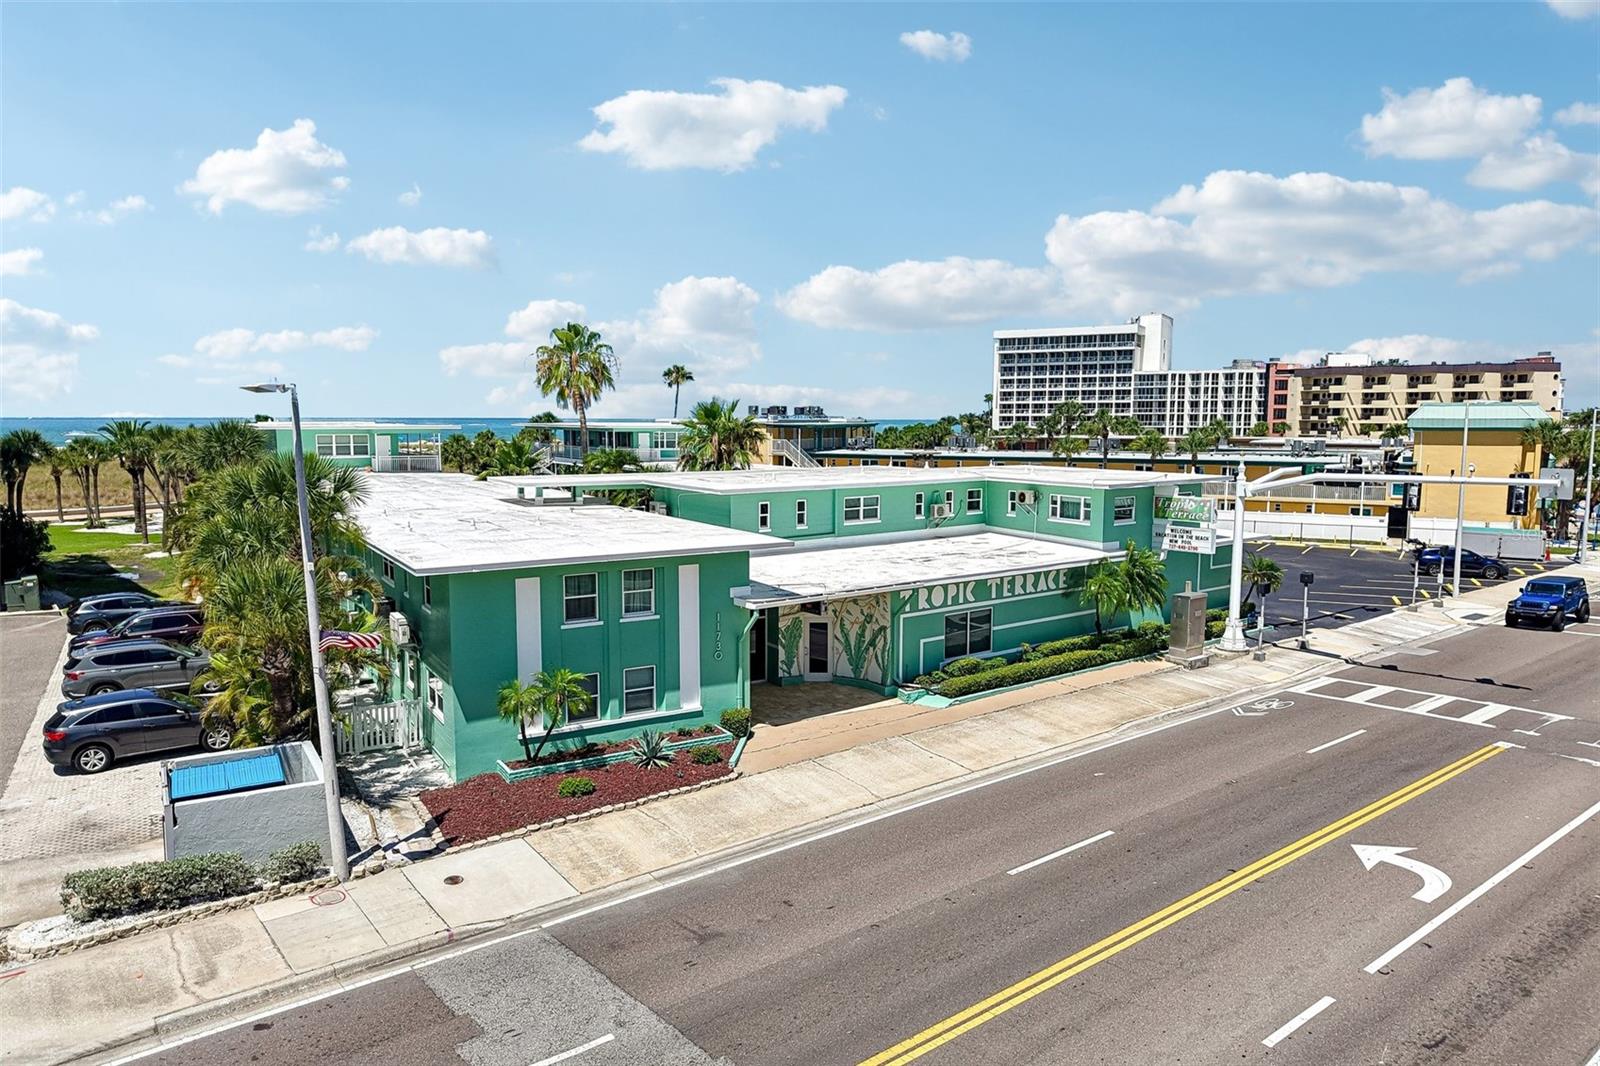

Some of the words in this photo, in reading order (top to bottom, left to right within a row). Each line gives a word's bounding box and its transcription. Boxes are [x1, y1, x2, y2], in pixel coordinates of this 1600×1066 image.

[1165, 508, 1209, 520] Terrace
[899, 582, 976, 612] TROPIC
[987, 568, 1068, 599] TERRACE
[714, 612, 723, 661] 11730
